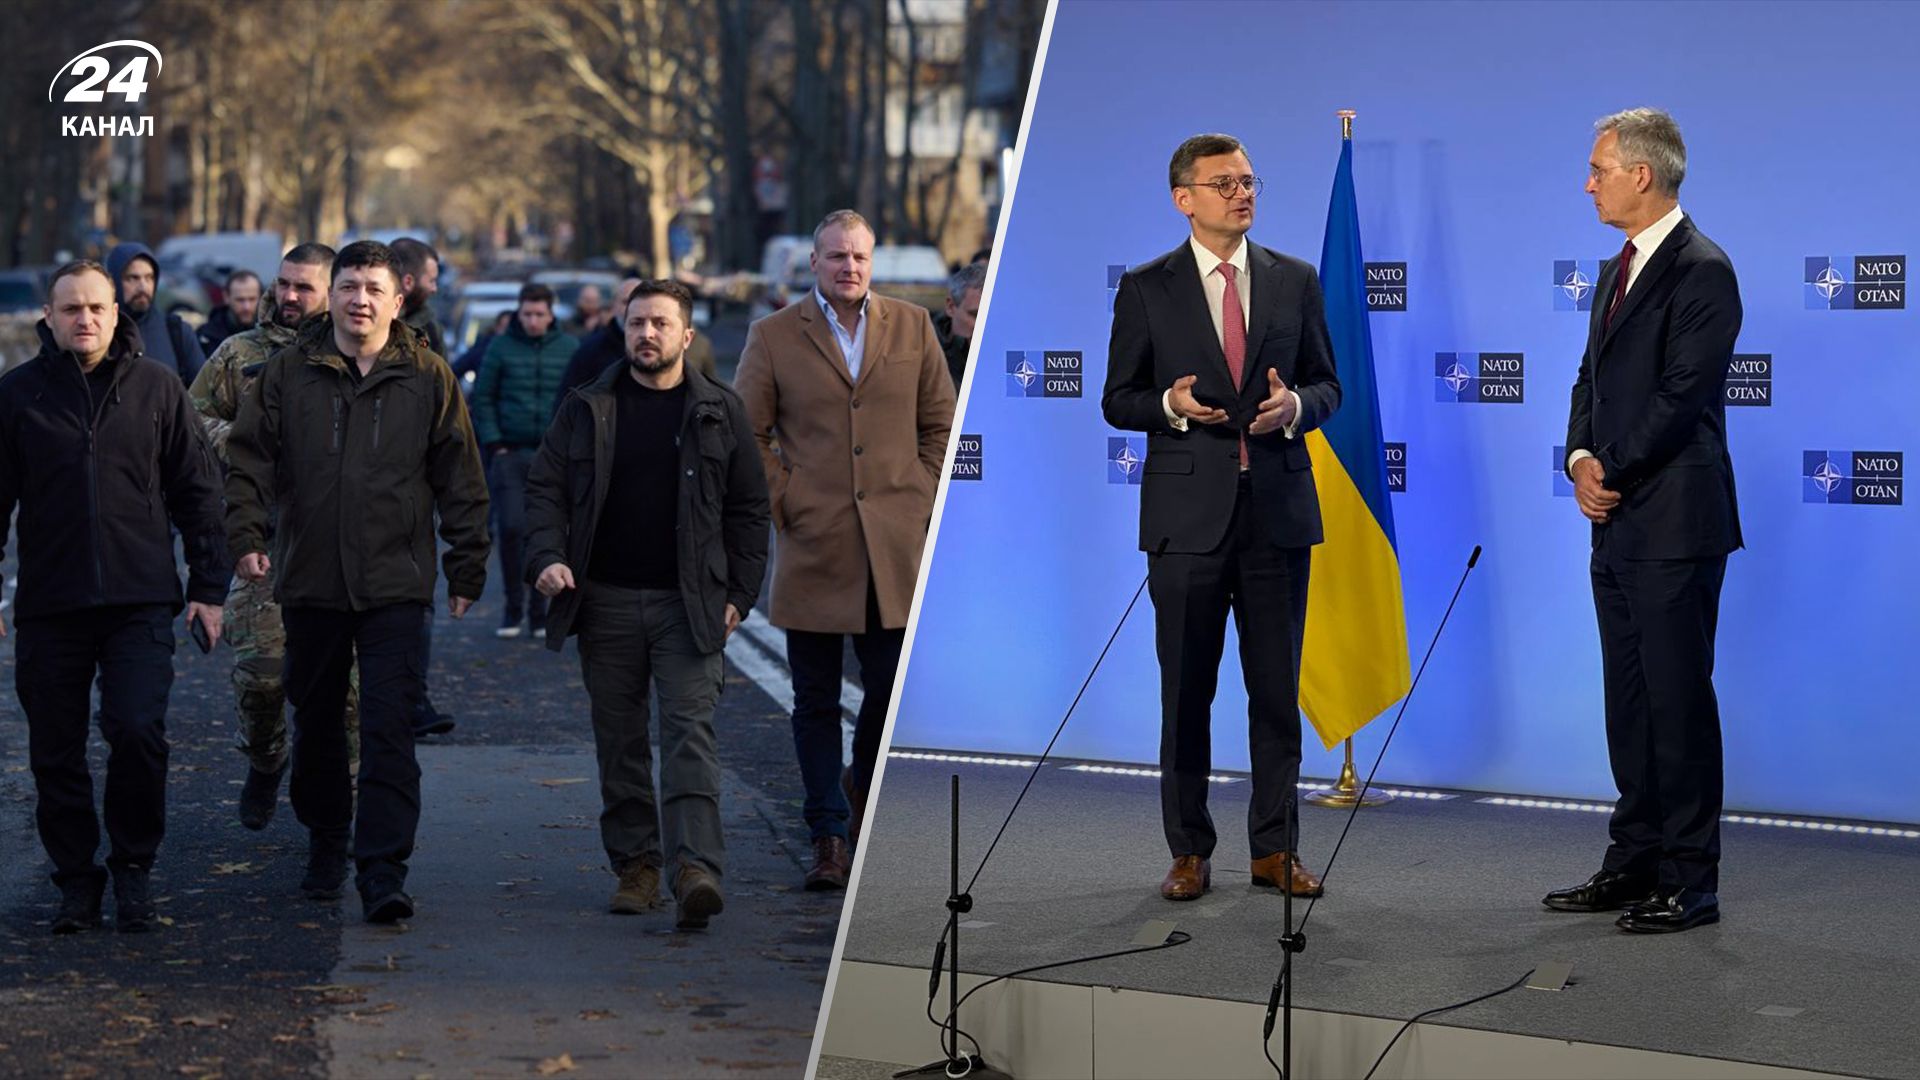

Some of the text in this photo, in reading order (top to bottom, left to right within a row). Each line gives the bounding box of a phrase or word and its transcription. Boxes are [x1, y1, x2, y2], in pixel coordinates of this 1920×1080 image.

[1367, 268, 1403, 281] NATO
[1859, 262, 1901, 276] NATO
[1366, 293, 1403, 307] OTAN
[1858, 289, 1901, 303] OTAN
[1047, 357, 1079, 369] NATO
[1483, 359, 1520, 372] NATO
[1728, 360, 1767, 374] NATO
[1046, 380, 1079, 392] OTAN
[1482, 384, 1520, 397] OTAN
[1727, 386, 1767, 400] OTAN
[957, 440, 979, 452] ATO
[1384, 449, 1403, 461] TO
[1856, 458, 1899, 471] NATO
[1855, 485, 1898, 498] OTAN
